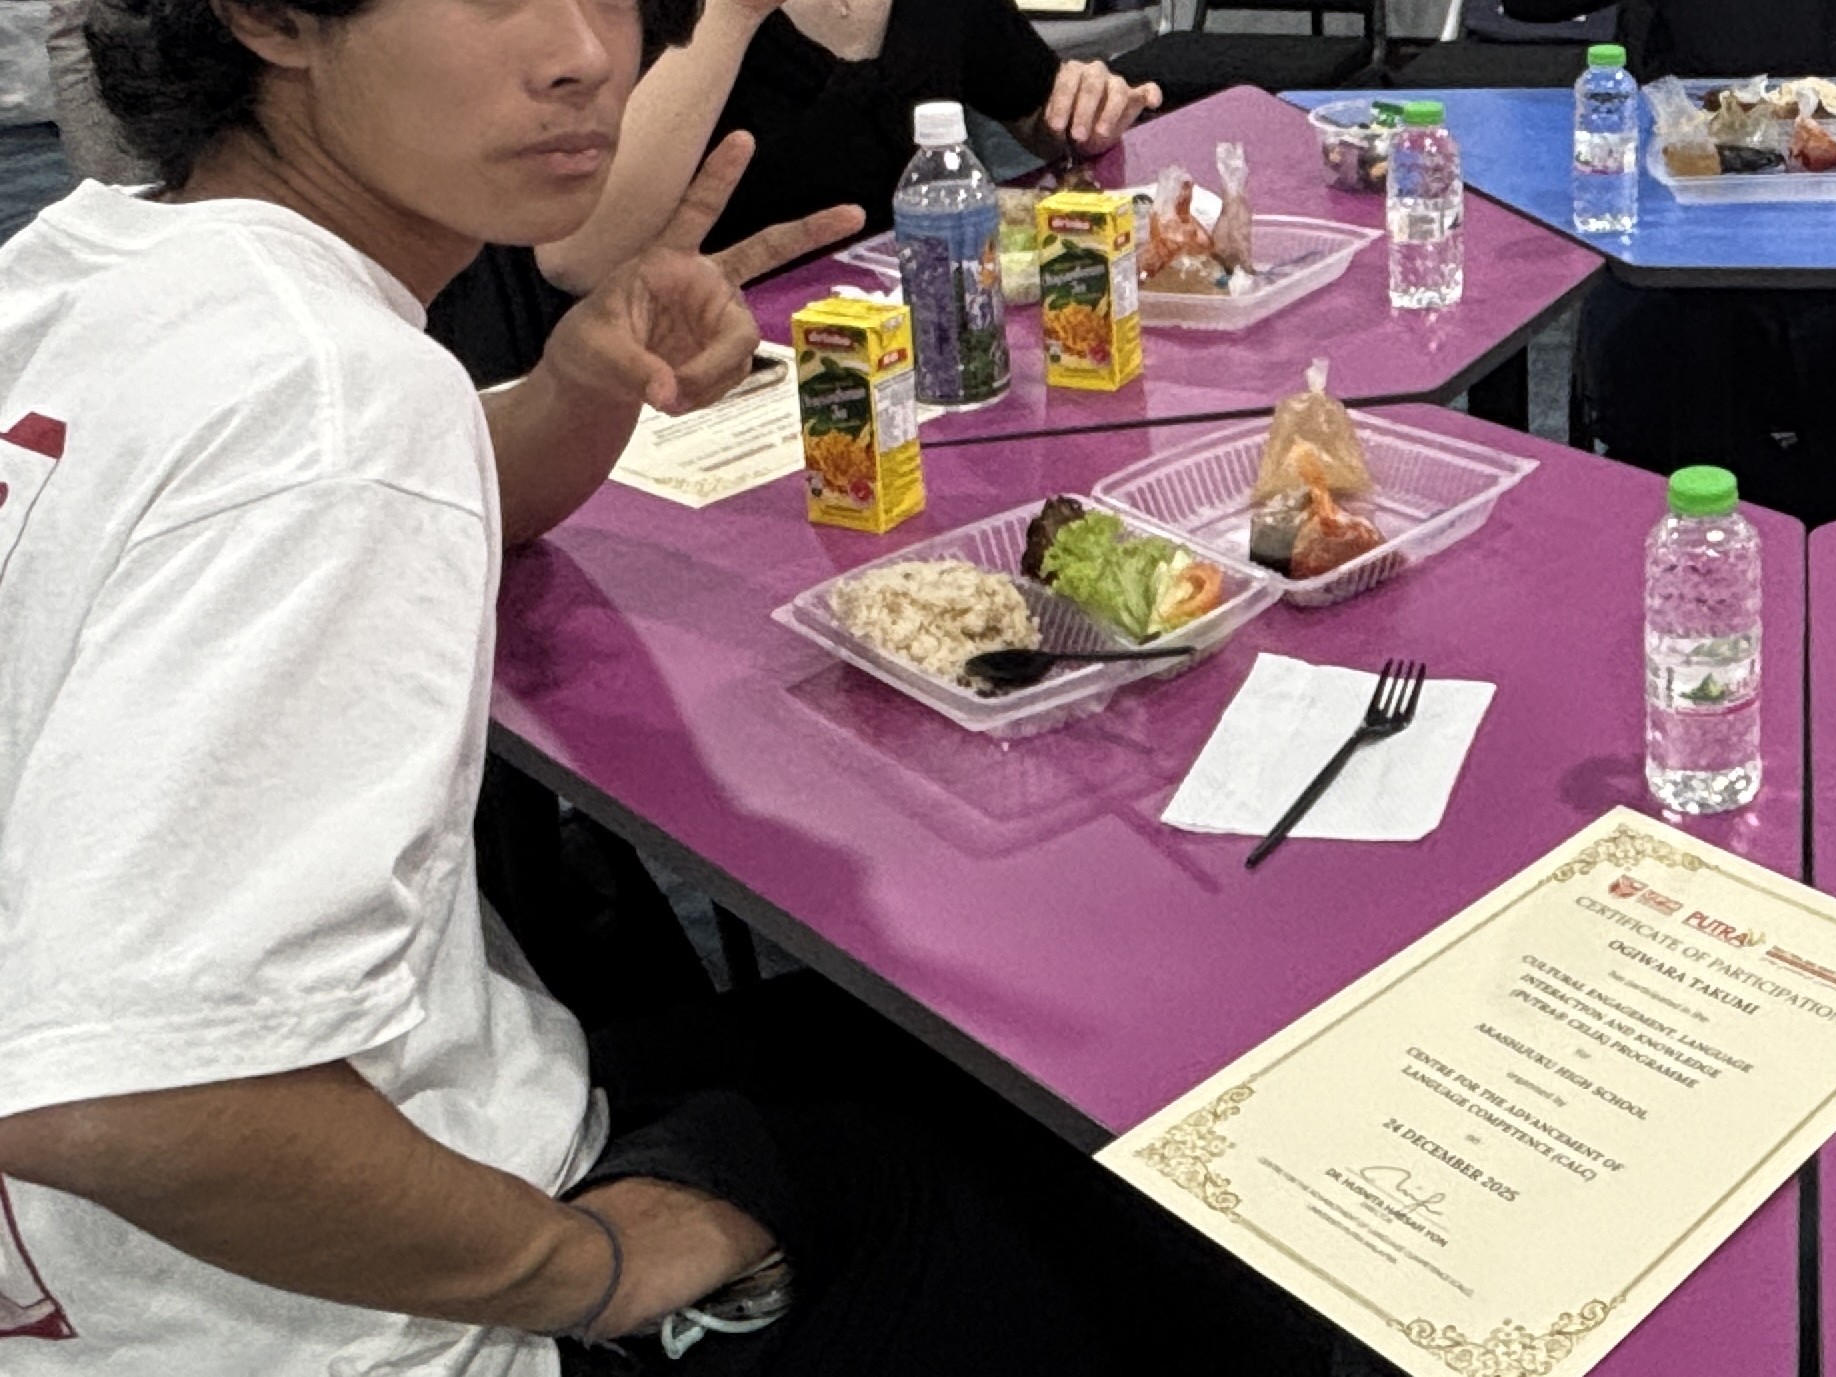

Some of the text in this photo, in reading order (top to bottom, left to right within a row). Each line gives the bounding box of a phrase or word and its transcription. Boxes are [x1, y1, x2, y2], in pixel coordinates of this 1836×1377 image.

[1575, 896, 1683, 951] CERTIFICATE
[1682, 945, 1711, 964] OF
[1683, 910, 1749, 948] PUTRA
[1521, 954, 1586, 992] CULTURAL
[1677, 1034, 1754, 1075] LANGUAGE
[1608, 939, 1761, 1016] OGIWARA TAKUMI
[1520, 973, 1722, 1079] INTERACTION AND KNOWLEDGE
[1610, 1040, 1700, 1089] PROGRAMME
[1401, 1064, 1599, 1183] LANGUAGE COMPETENCE (CALC)
[1406, 1046, 1626, 1173] CENTRE FOR THE ADVANCEMENT OF
[1554, 1066, 1594, 1091] HIGH
[1592, 1086, 1648, 1121] SCHOOL
[1382, 1117, 1521, 1203] 24 DECEMBER 2025
